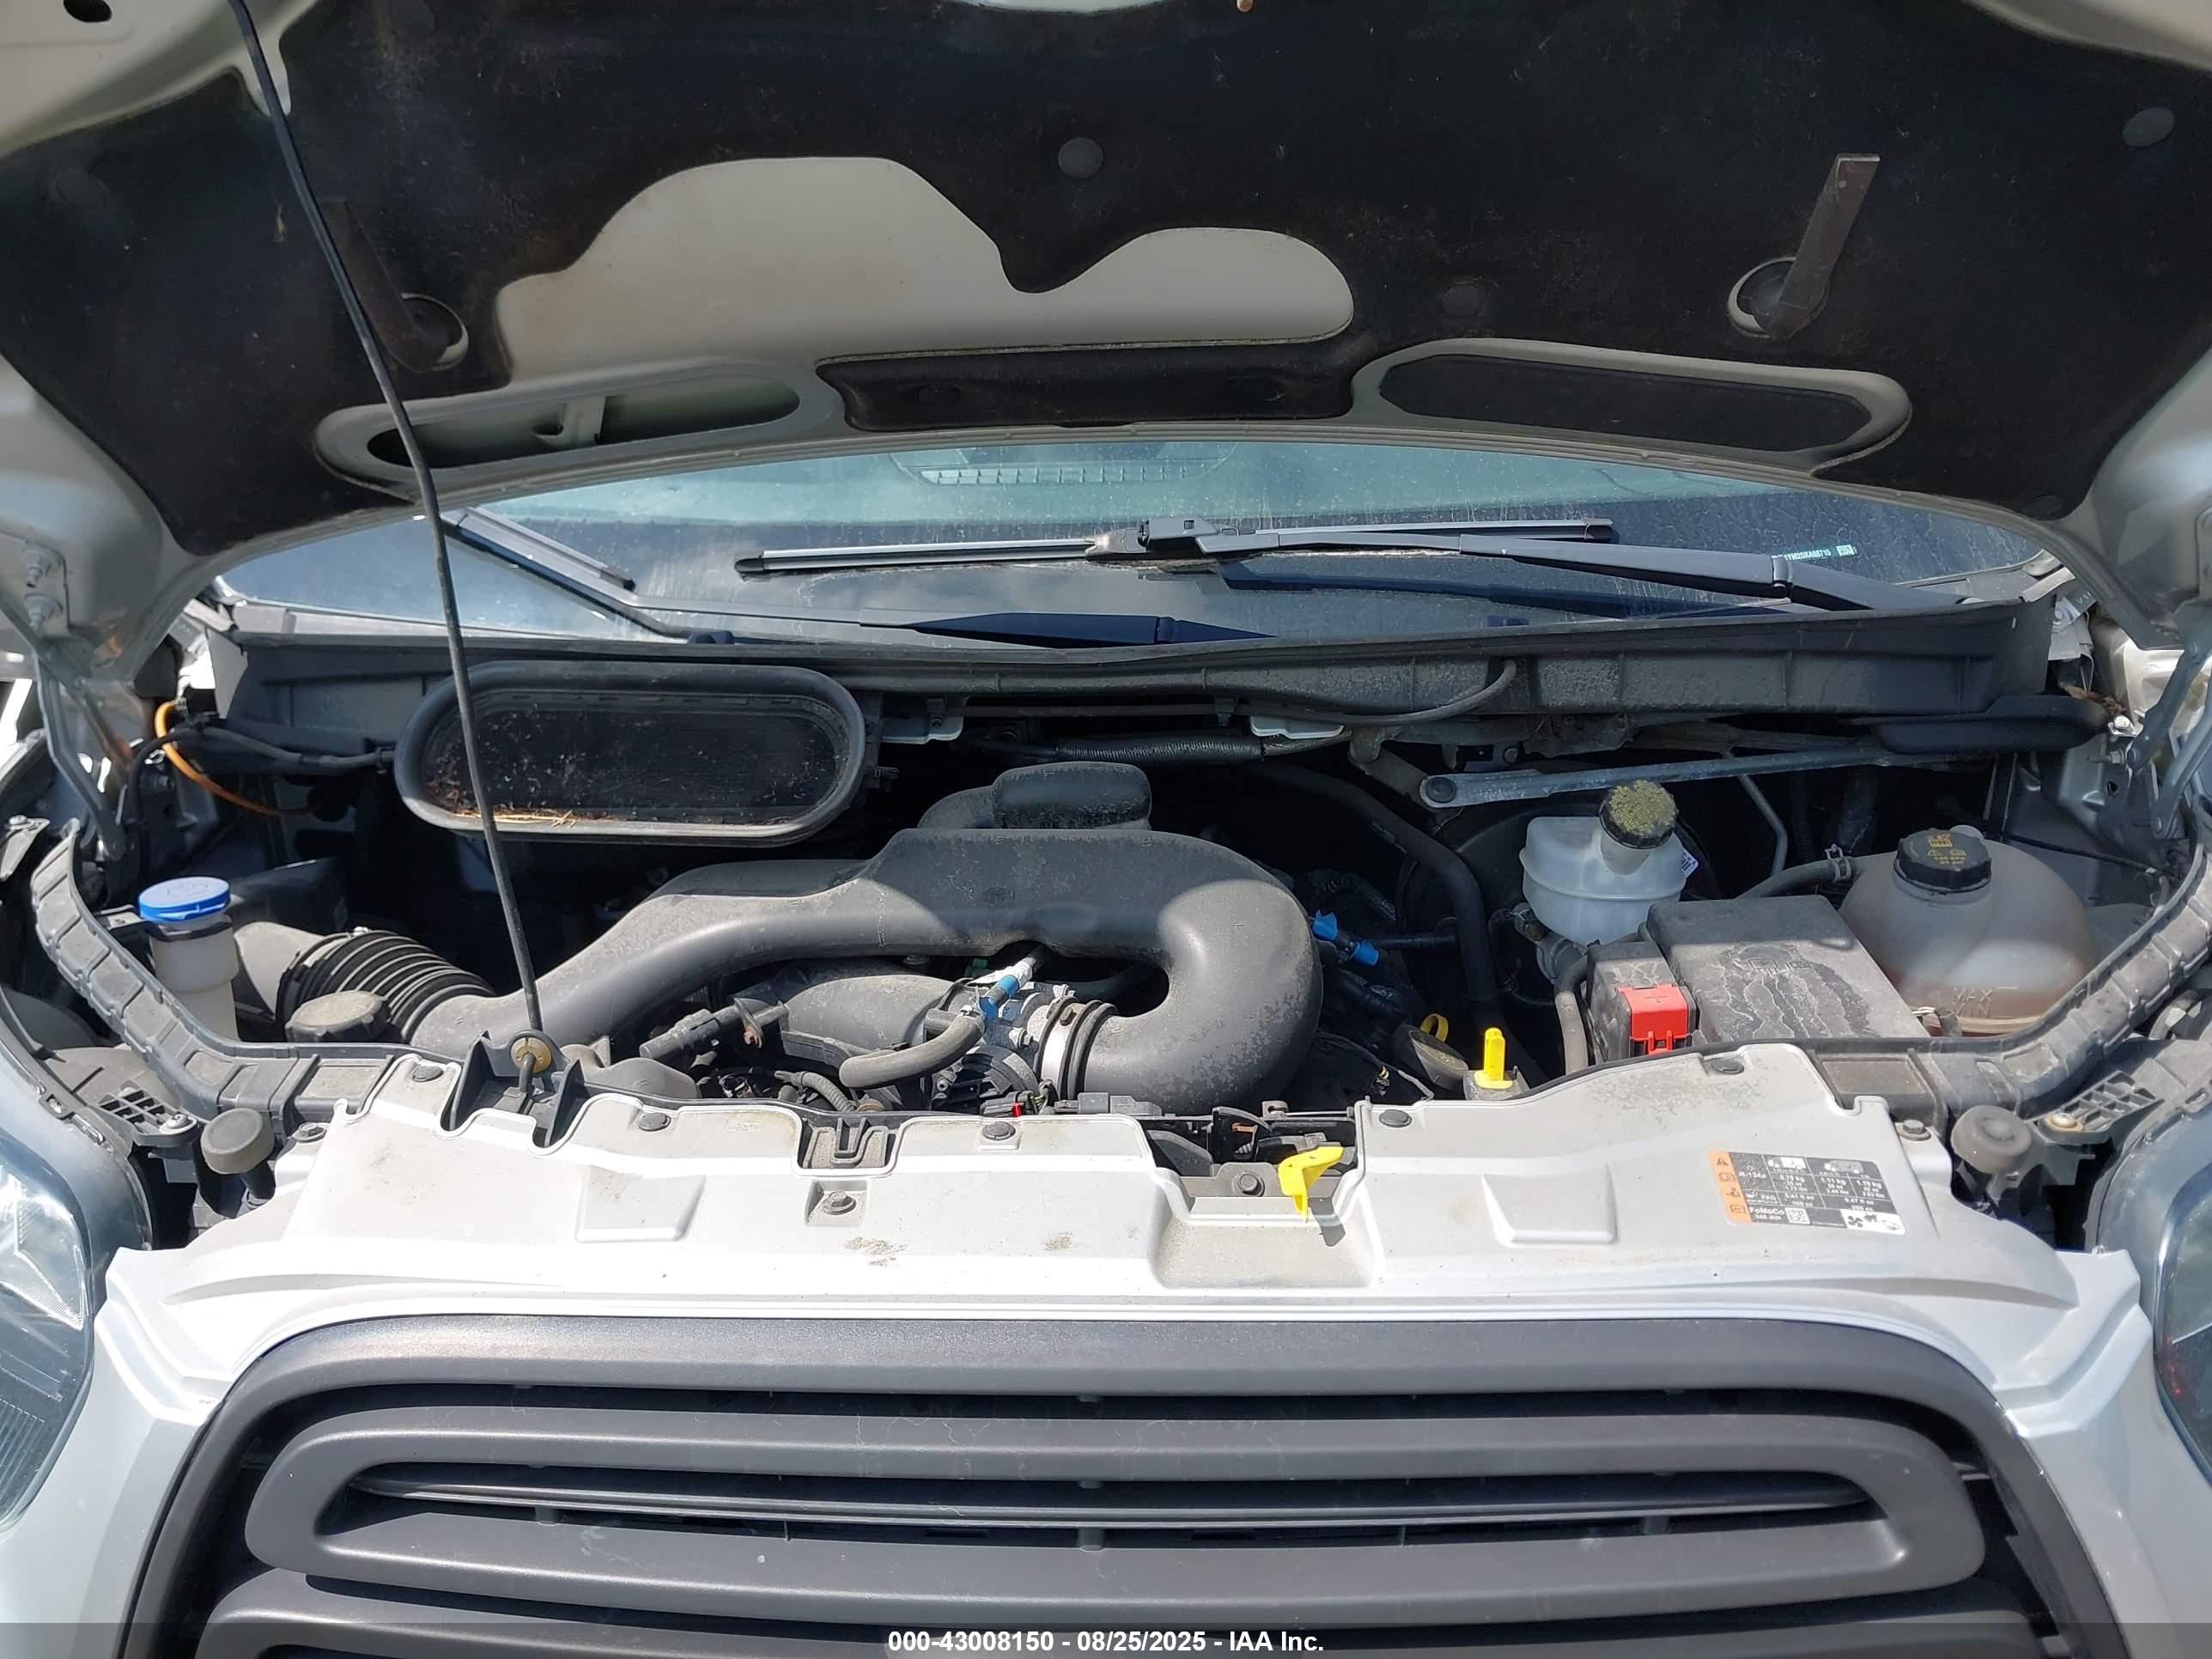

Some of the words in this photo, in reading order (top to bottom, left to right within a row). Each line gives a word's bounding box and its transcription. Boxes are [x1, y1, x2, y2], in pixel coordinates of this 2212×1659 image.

[1954, 987, 1993, 1003] MAX
[1953, 1002, 1990, 1018] MIN
[1739, 1170, 1766, 1180] R-134a
[1748, 1206, 1785, 1215] FoMoCo
